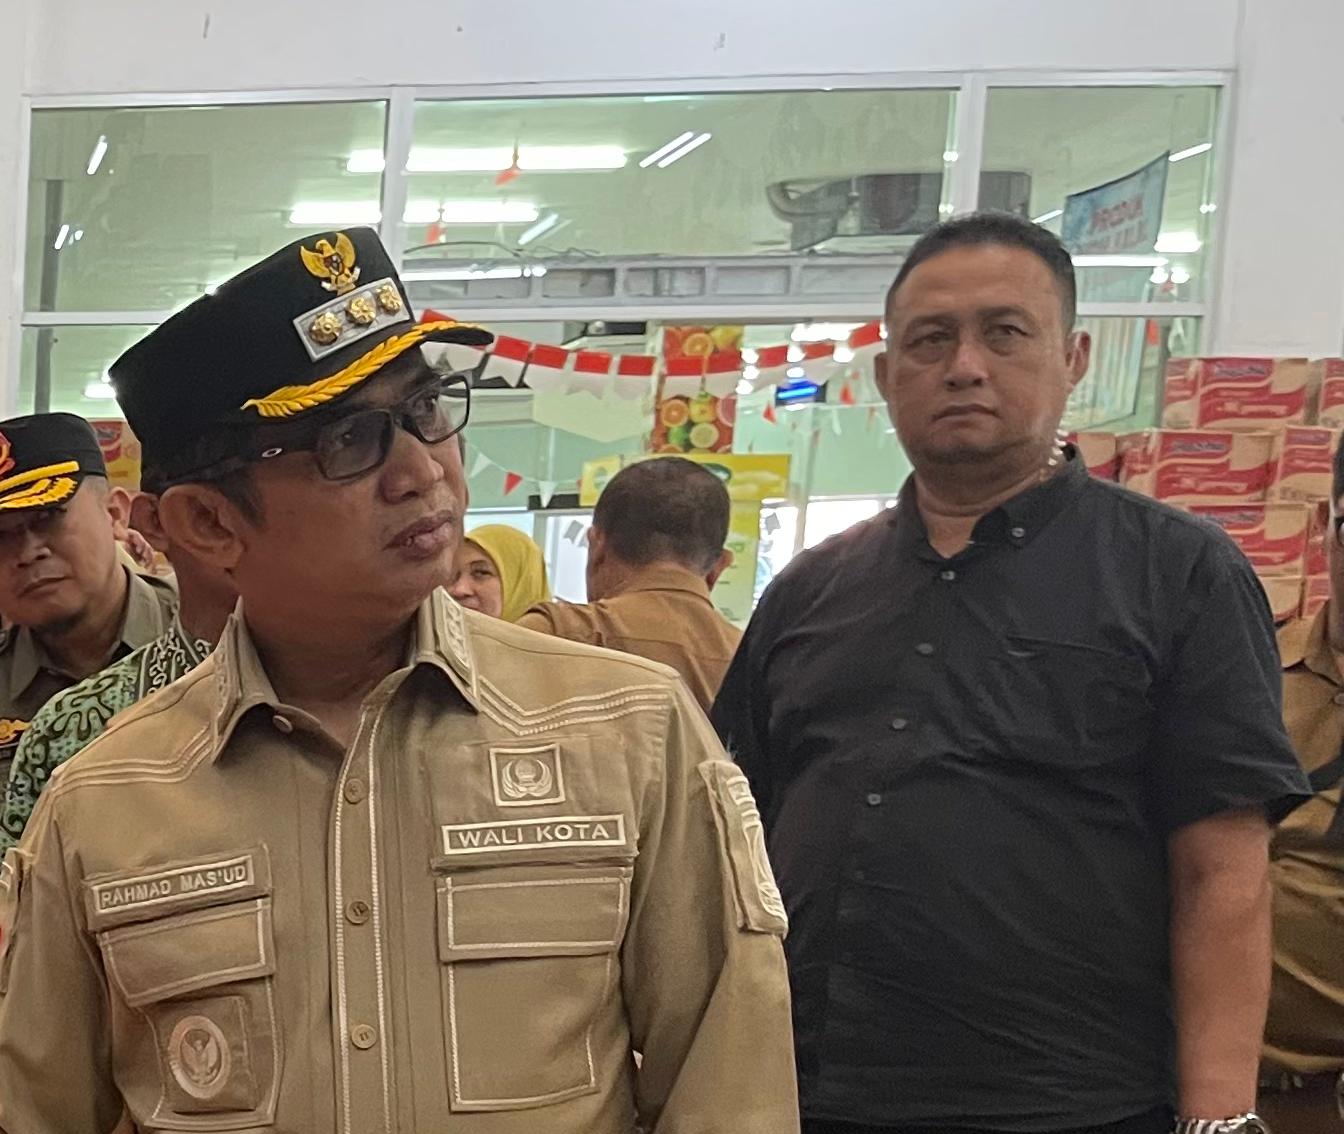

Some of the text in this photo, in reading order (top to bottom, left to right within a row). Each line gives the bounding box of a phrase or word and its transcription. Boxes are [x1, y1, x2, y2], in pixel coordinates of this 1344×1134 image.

[459, 824, 610, 848] WALI KOTA
[100, 865, 246, 908] RAHMAD MAS'UD
